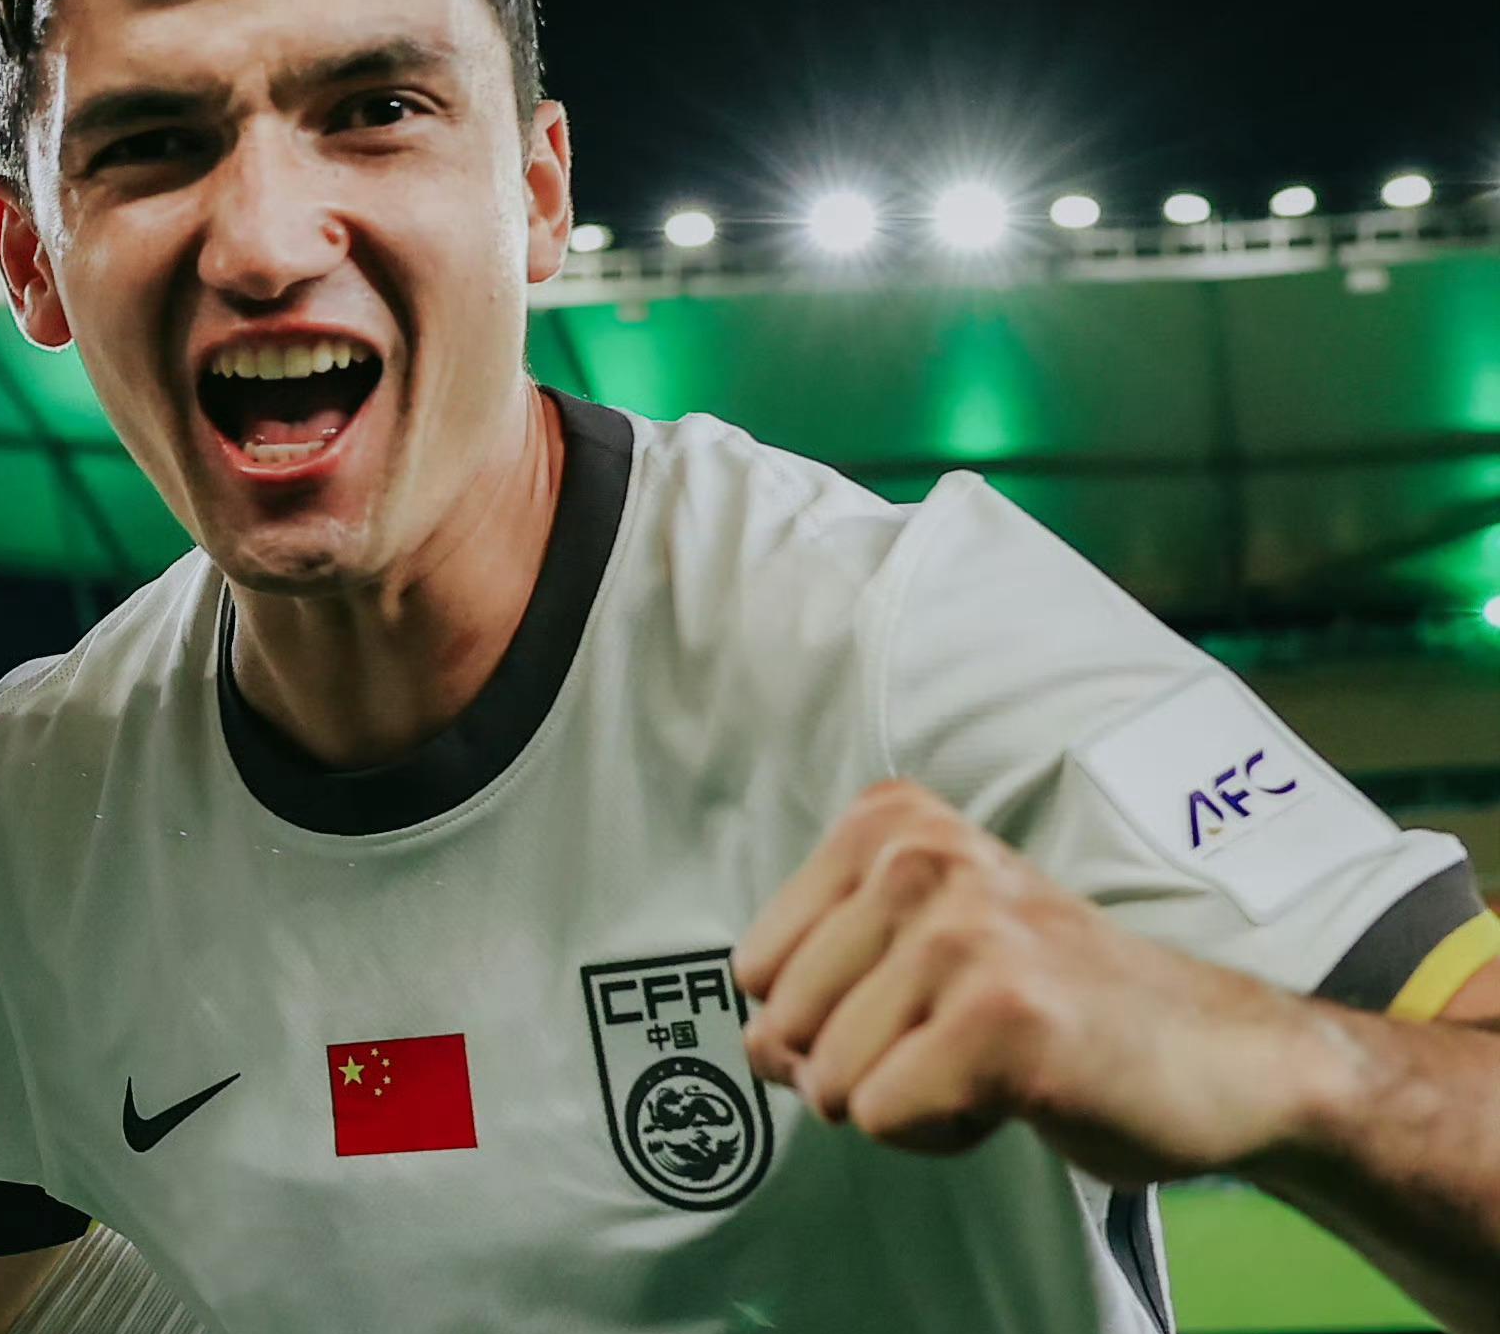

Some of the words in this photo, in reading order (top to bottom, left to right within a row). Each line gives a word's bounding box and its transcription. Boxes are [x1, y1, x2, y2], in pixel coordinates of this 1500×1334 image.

[1189, 749, 1297, 849] AFC
[599, 968, 730, 1025] CFA
[646, 1020, 698, 1052] 中国
